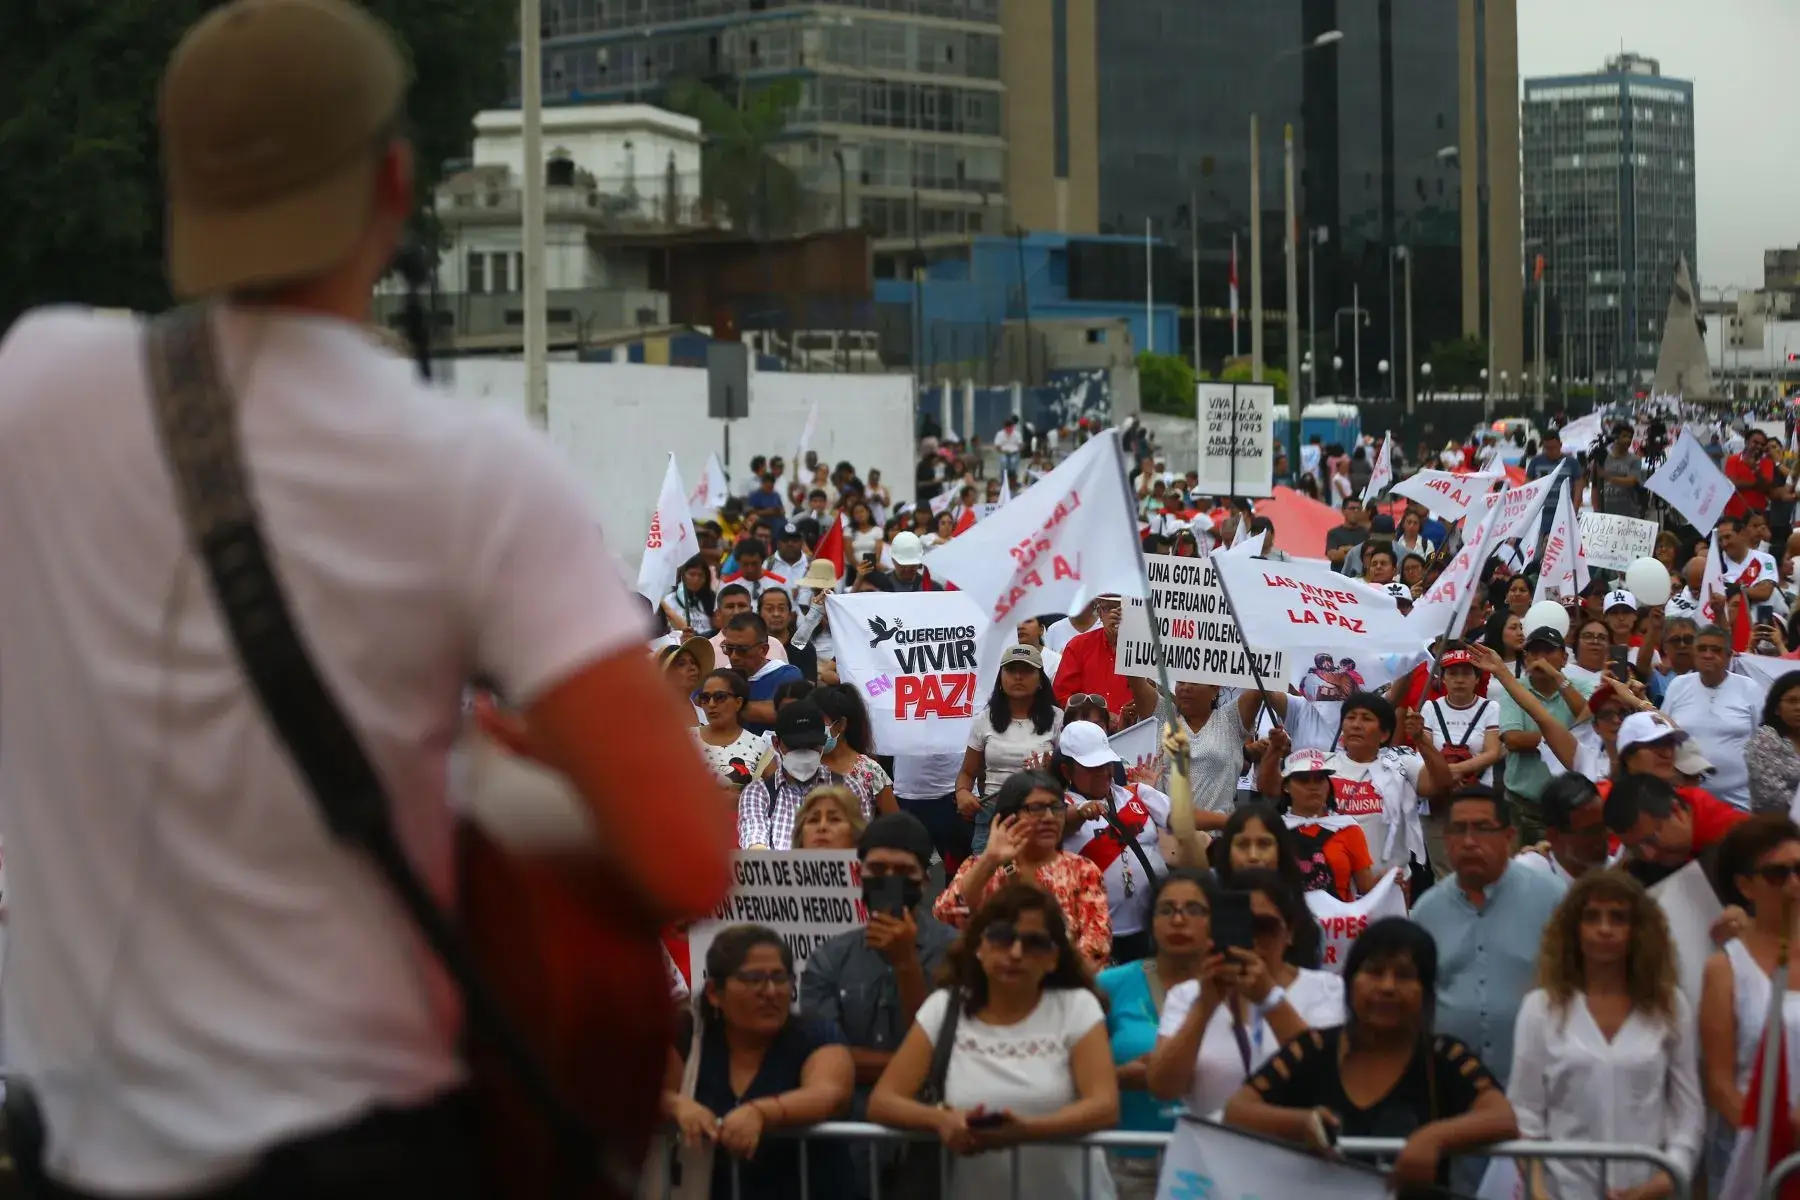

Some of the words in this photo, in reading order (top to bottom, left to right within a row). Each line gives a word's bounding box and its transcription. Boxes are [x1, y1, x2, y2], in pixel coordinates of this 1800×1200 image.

[1209, 398, 1230, 409] VIVA
[1240, 398, 1255, 410] LA
[1208, 435, 1239, 446] ABAJO
[1242, 437, 1255, 446] LA
[1209, 423, 1223, 432] DE
[1239, 423, 1263, 433] 1993
[1149, 562, 1170, 582] UNA
[1173, 565, 1200, 587] GOTA
[1203, 567, 1217, 588] DE
[1262, 572, 1298, 589] LAS
[1299, 581, 1359, 605] MYPES
[1613, 591, 1625, 602] LA
[1164, 590, 1216, 615] PERUANO
[1300, 592, 1339, 611] POR
[1171, 615, 1195, 640] MÁS
[1287, 609, 1319, 624] LA
[1323, 611, 1368, 634] PAZ
[894, 625, 976, 644] QUEREMOS
[894, 639, 977, 675] VIVIR
[1203, 648, 1228, 673] POR
[1230, 651, 1245, 675] LA
[864, 673, 893, 697] EN
[894, 672, 977, 720] PAZ!
[734, 860, 773, 886] GOTA
[772, 861, 793, 887] DE
[793, 860, 849, 887] SANGRE
[734, 895, 799, 922] PERUANO
[801, 897, 853, 924] HERIDO
